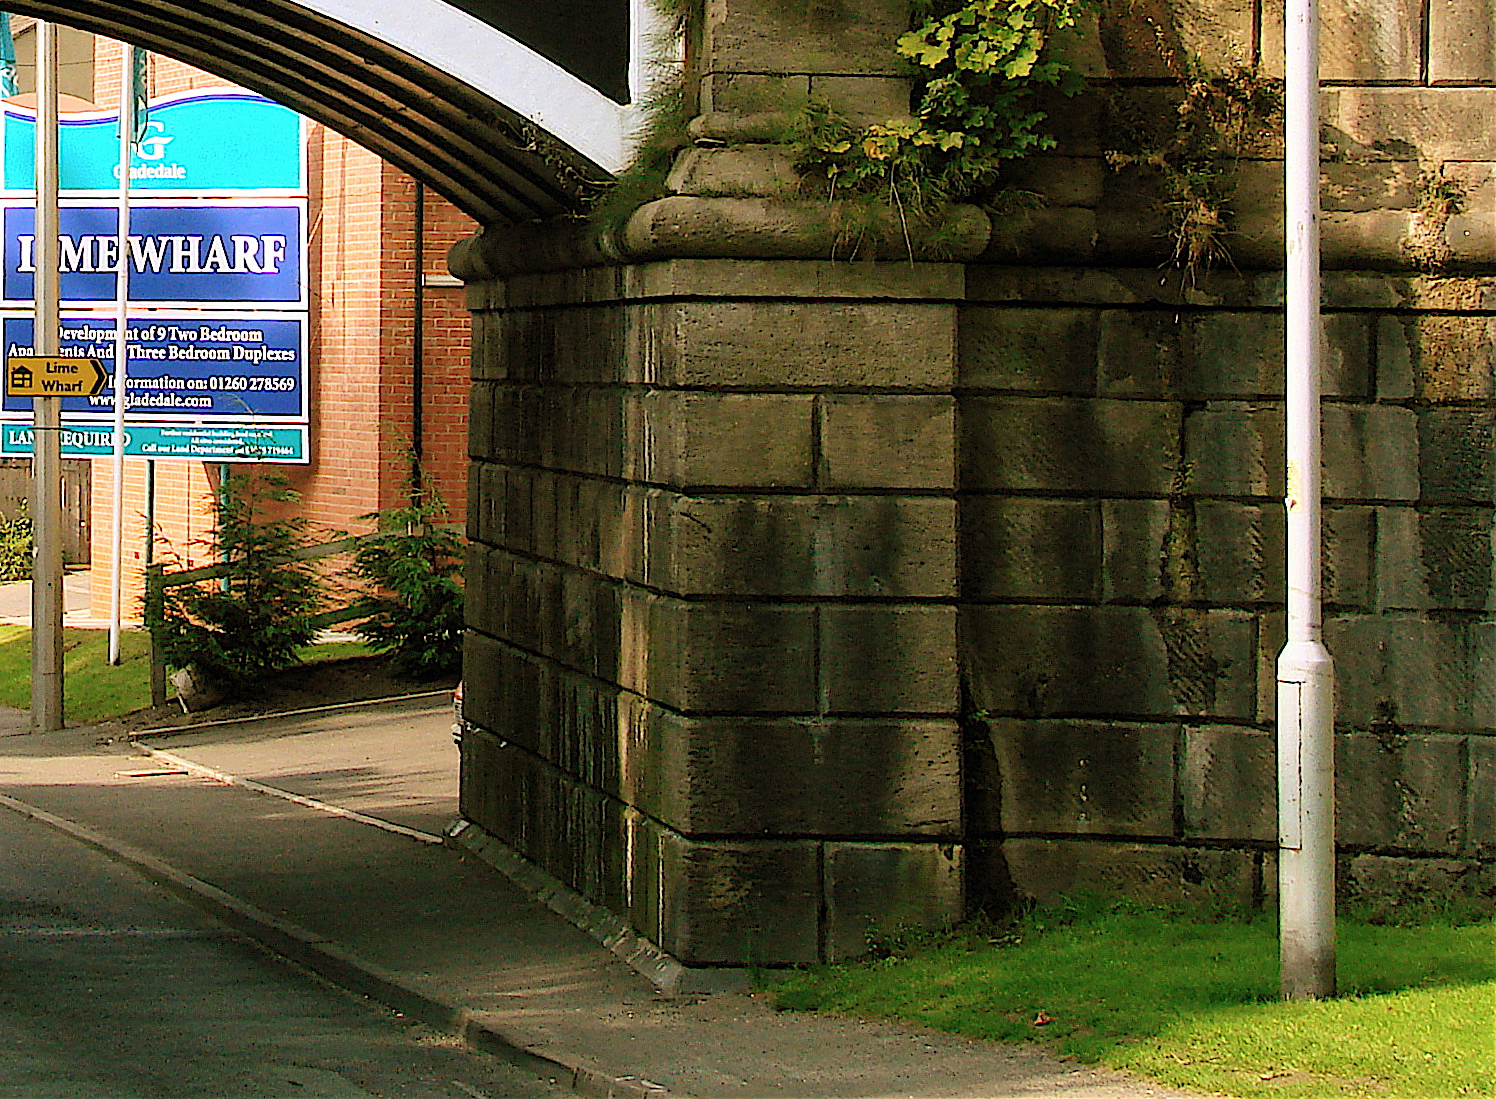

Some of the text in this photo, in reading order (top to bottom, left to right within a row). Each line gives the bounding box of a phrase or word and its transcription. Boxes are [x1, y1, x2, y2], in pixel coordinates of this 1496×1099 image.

[112, 162, 187, 180] Gadedale
[127, 234, 286, 274] WHARF
[58, 325, 263, 343] evelopmnt of 9 Two Bedroom
[87, 344, 114, 359] And
[126, 345, 166, 359] Three
[168, 345, 230, 360] Bedroom
[233, 346, 295, 364] Duplexes
[45, 362, 79, 374] Lime
[41, 380, 83, 392] Wharf
[209, 376, 247, 390] 01260
[249, 377, 295, 391] 278569
[89, 392, 212, 409] wwwgladedale.com
